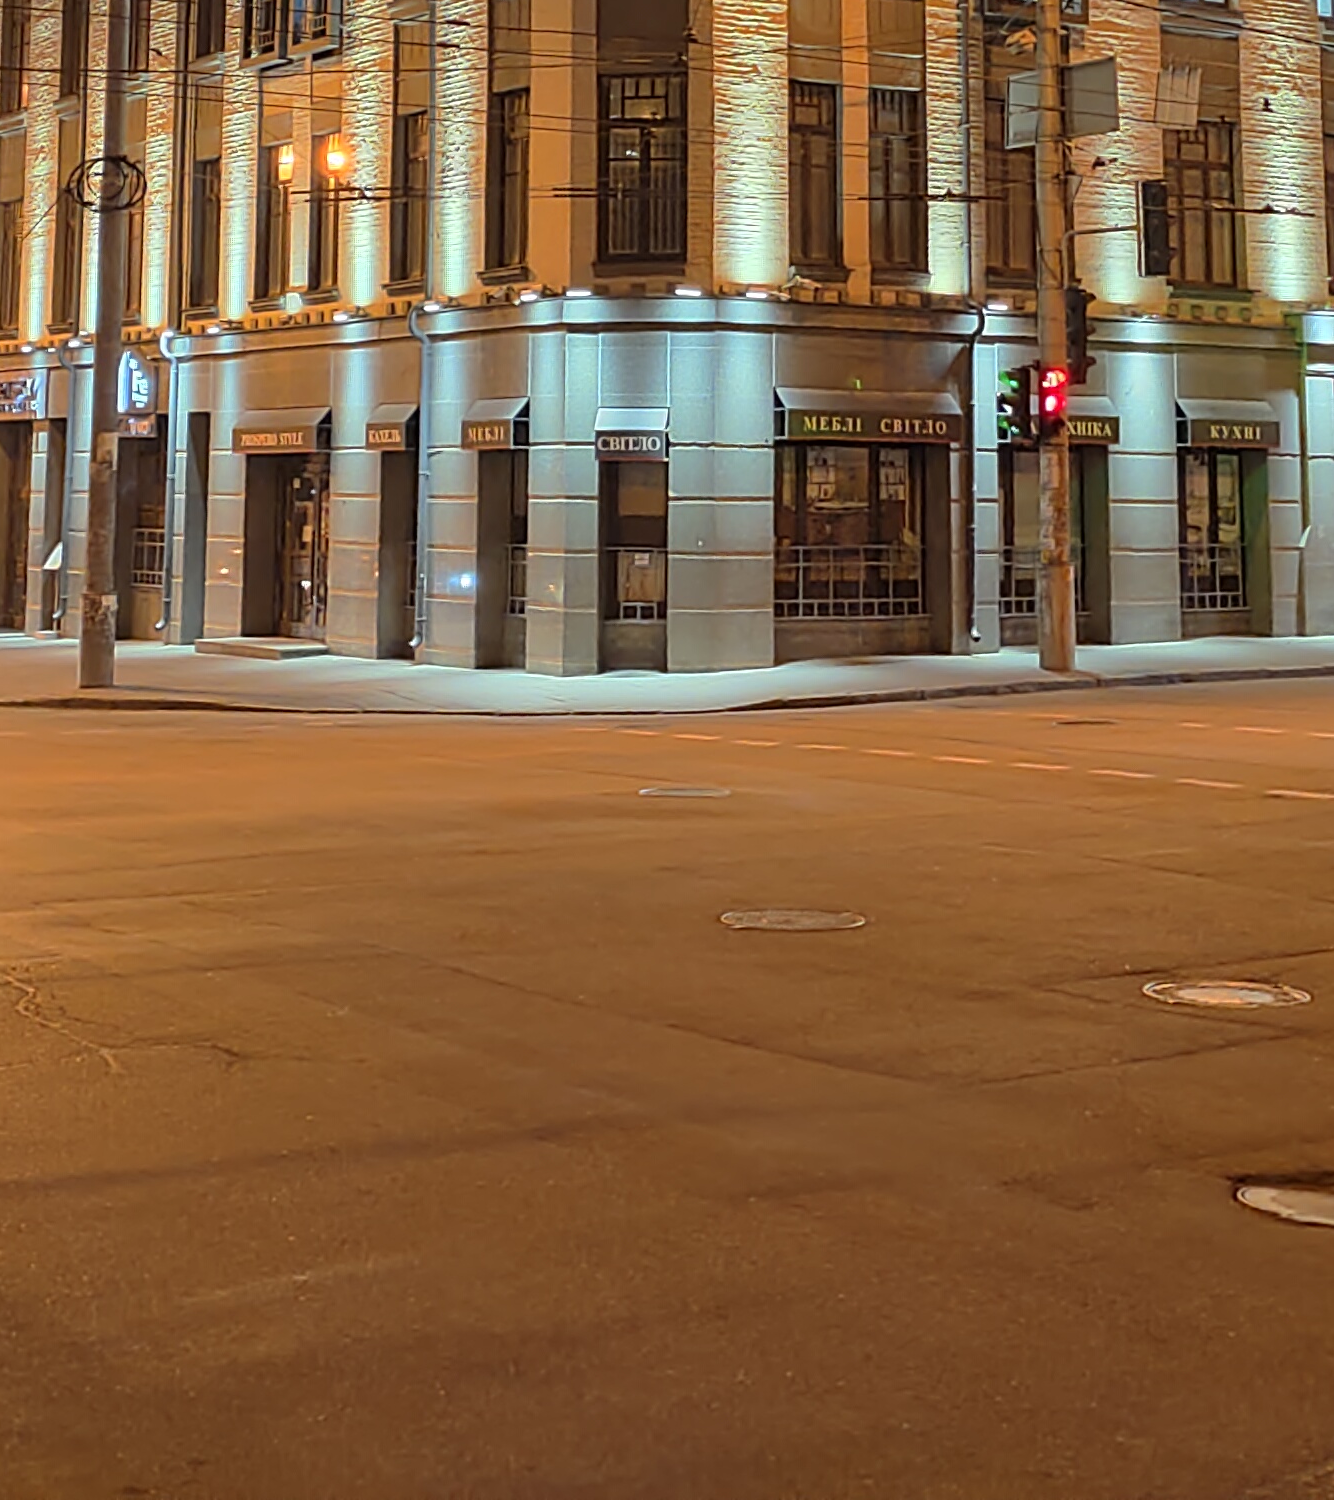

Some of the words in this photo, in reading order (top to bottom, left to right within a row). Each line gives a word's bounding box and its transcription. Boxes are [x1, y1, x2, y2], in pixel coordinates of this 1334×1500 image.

[803, 415, 862, 433] МЕБЛІ
[880, 418, 947, 435] СВІТЛО
[1209, 424, 1262, 440] КУХНІ
[467, 426, 505, 443] МЕБЛІ
[596, 435, 662, 452] СВІТЛО
